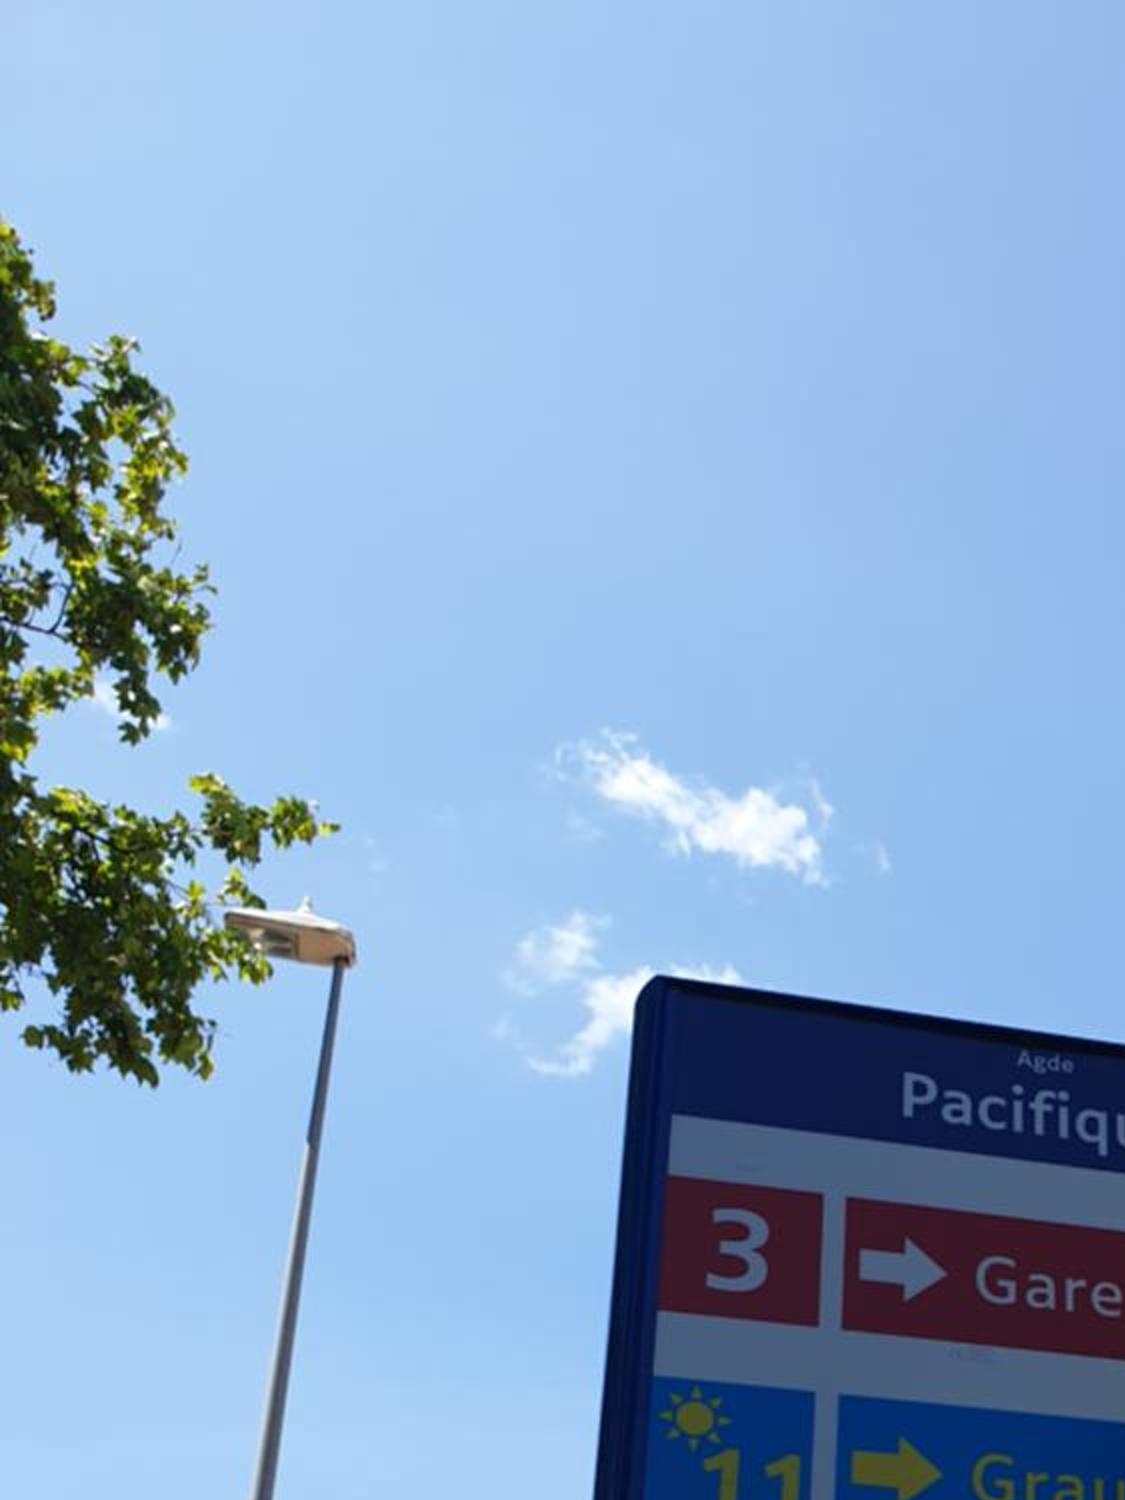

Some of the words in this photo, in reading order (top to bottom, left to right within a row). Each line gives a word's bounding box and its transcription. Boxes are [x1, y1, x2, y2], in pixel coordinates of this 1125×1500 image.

[1017, 1050, 1075, 1074] Agde
[705, 1208, 771, 1292] 3
[975, 1256, 1123, 1319] Gare
